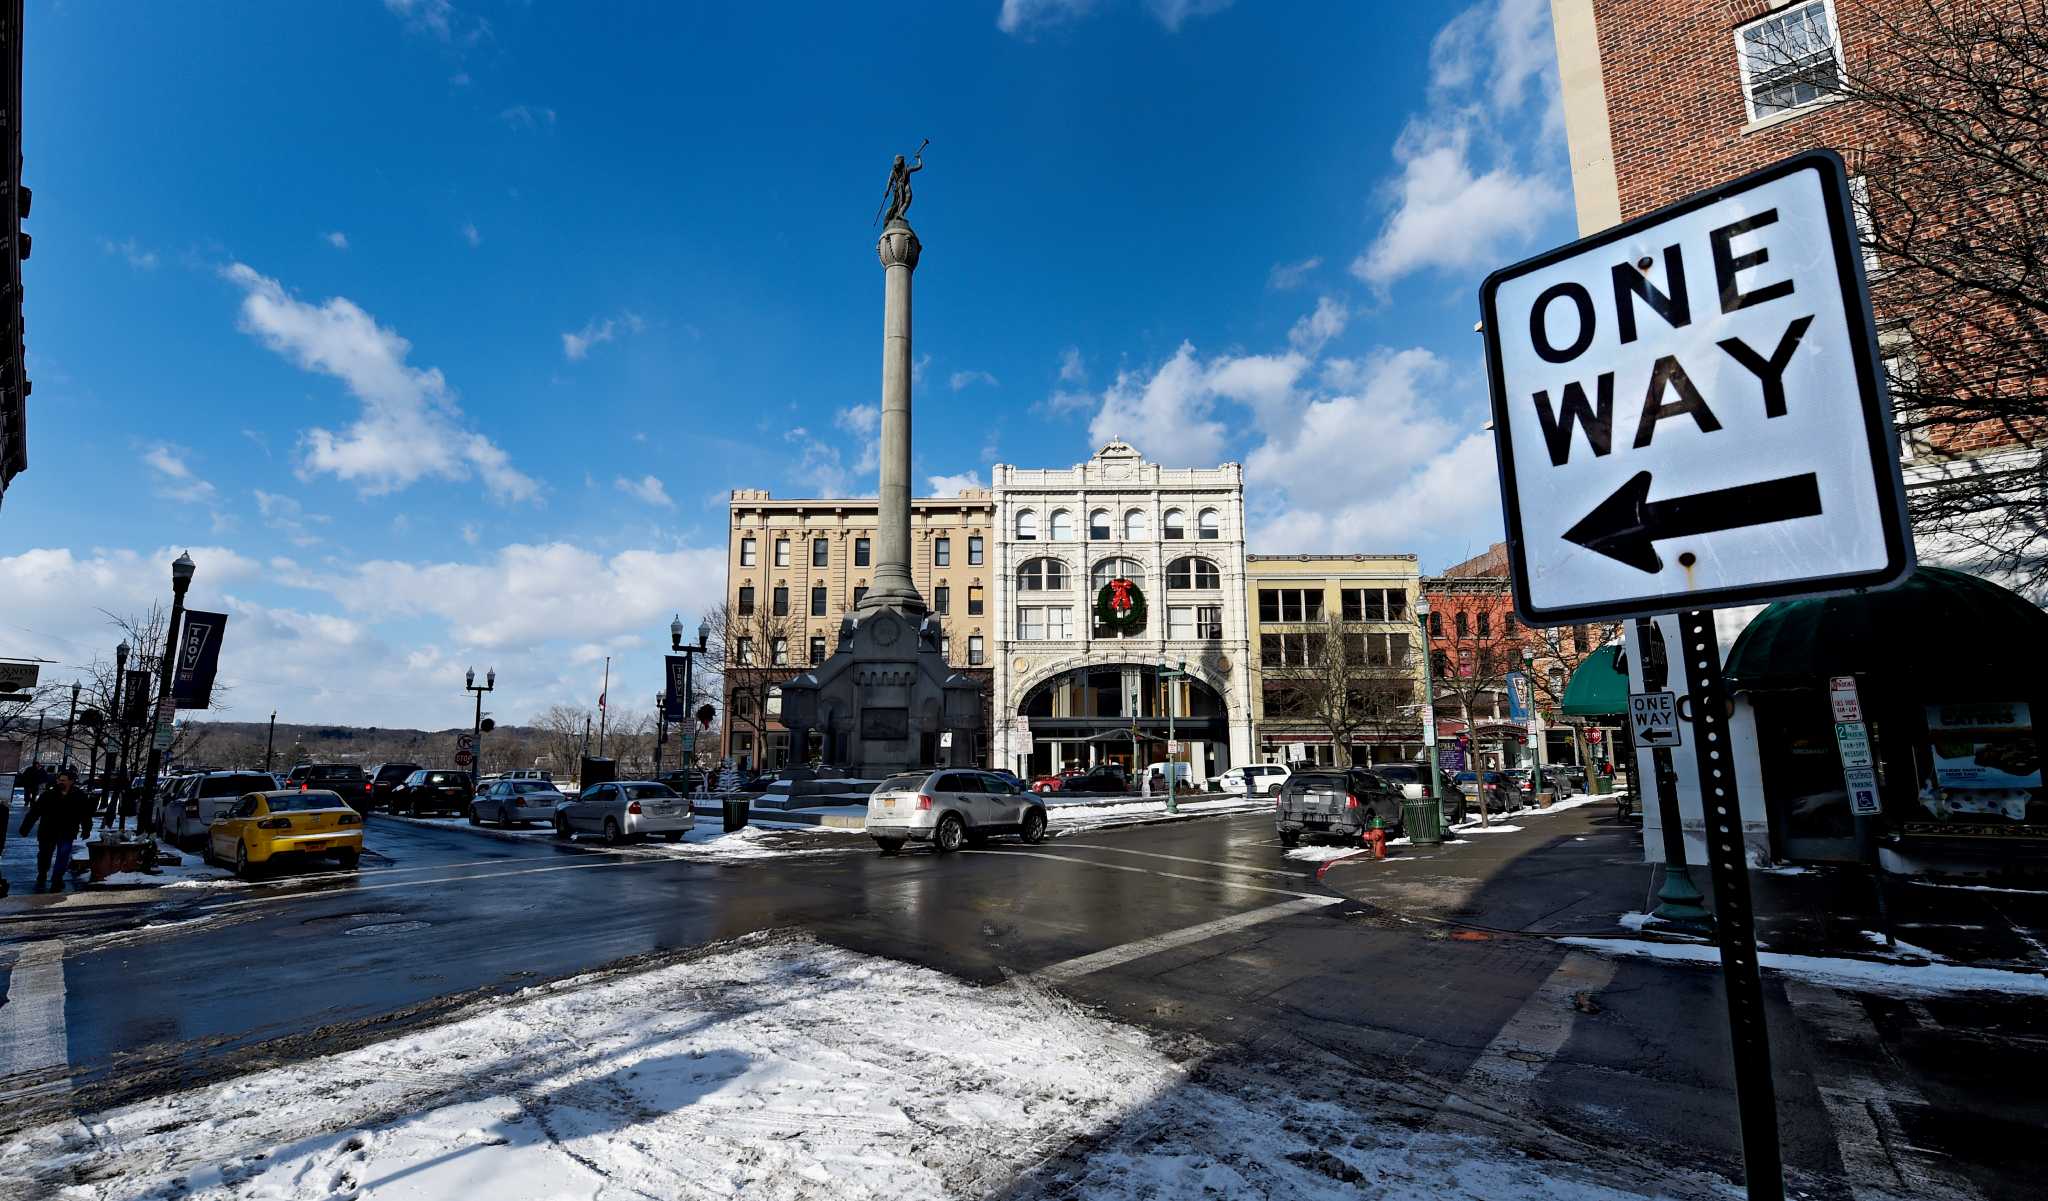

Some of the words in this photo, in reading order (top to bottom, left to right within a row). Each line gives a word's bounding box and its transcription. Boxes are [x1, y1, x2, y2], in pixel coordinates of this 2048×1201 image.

[1529, 207, 1796, 364] ONE
[1531, 313, 1815, 468] WAY
[188, 627, 202, 664] TROY
[1634, 697, 1670, 711] ONE
[1635, 711, 1672, 726] WAY
[1838, 726, 1846, 738] 2
[456, 754, 472, 764] STOP
